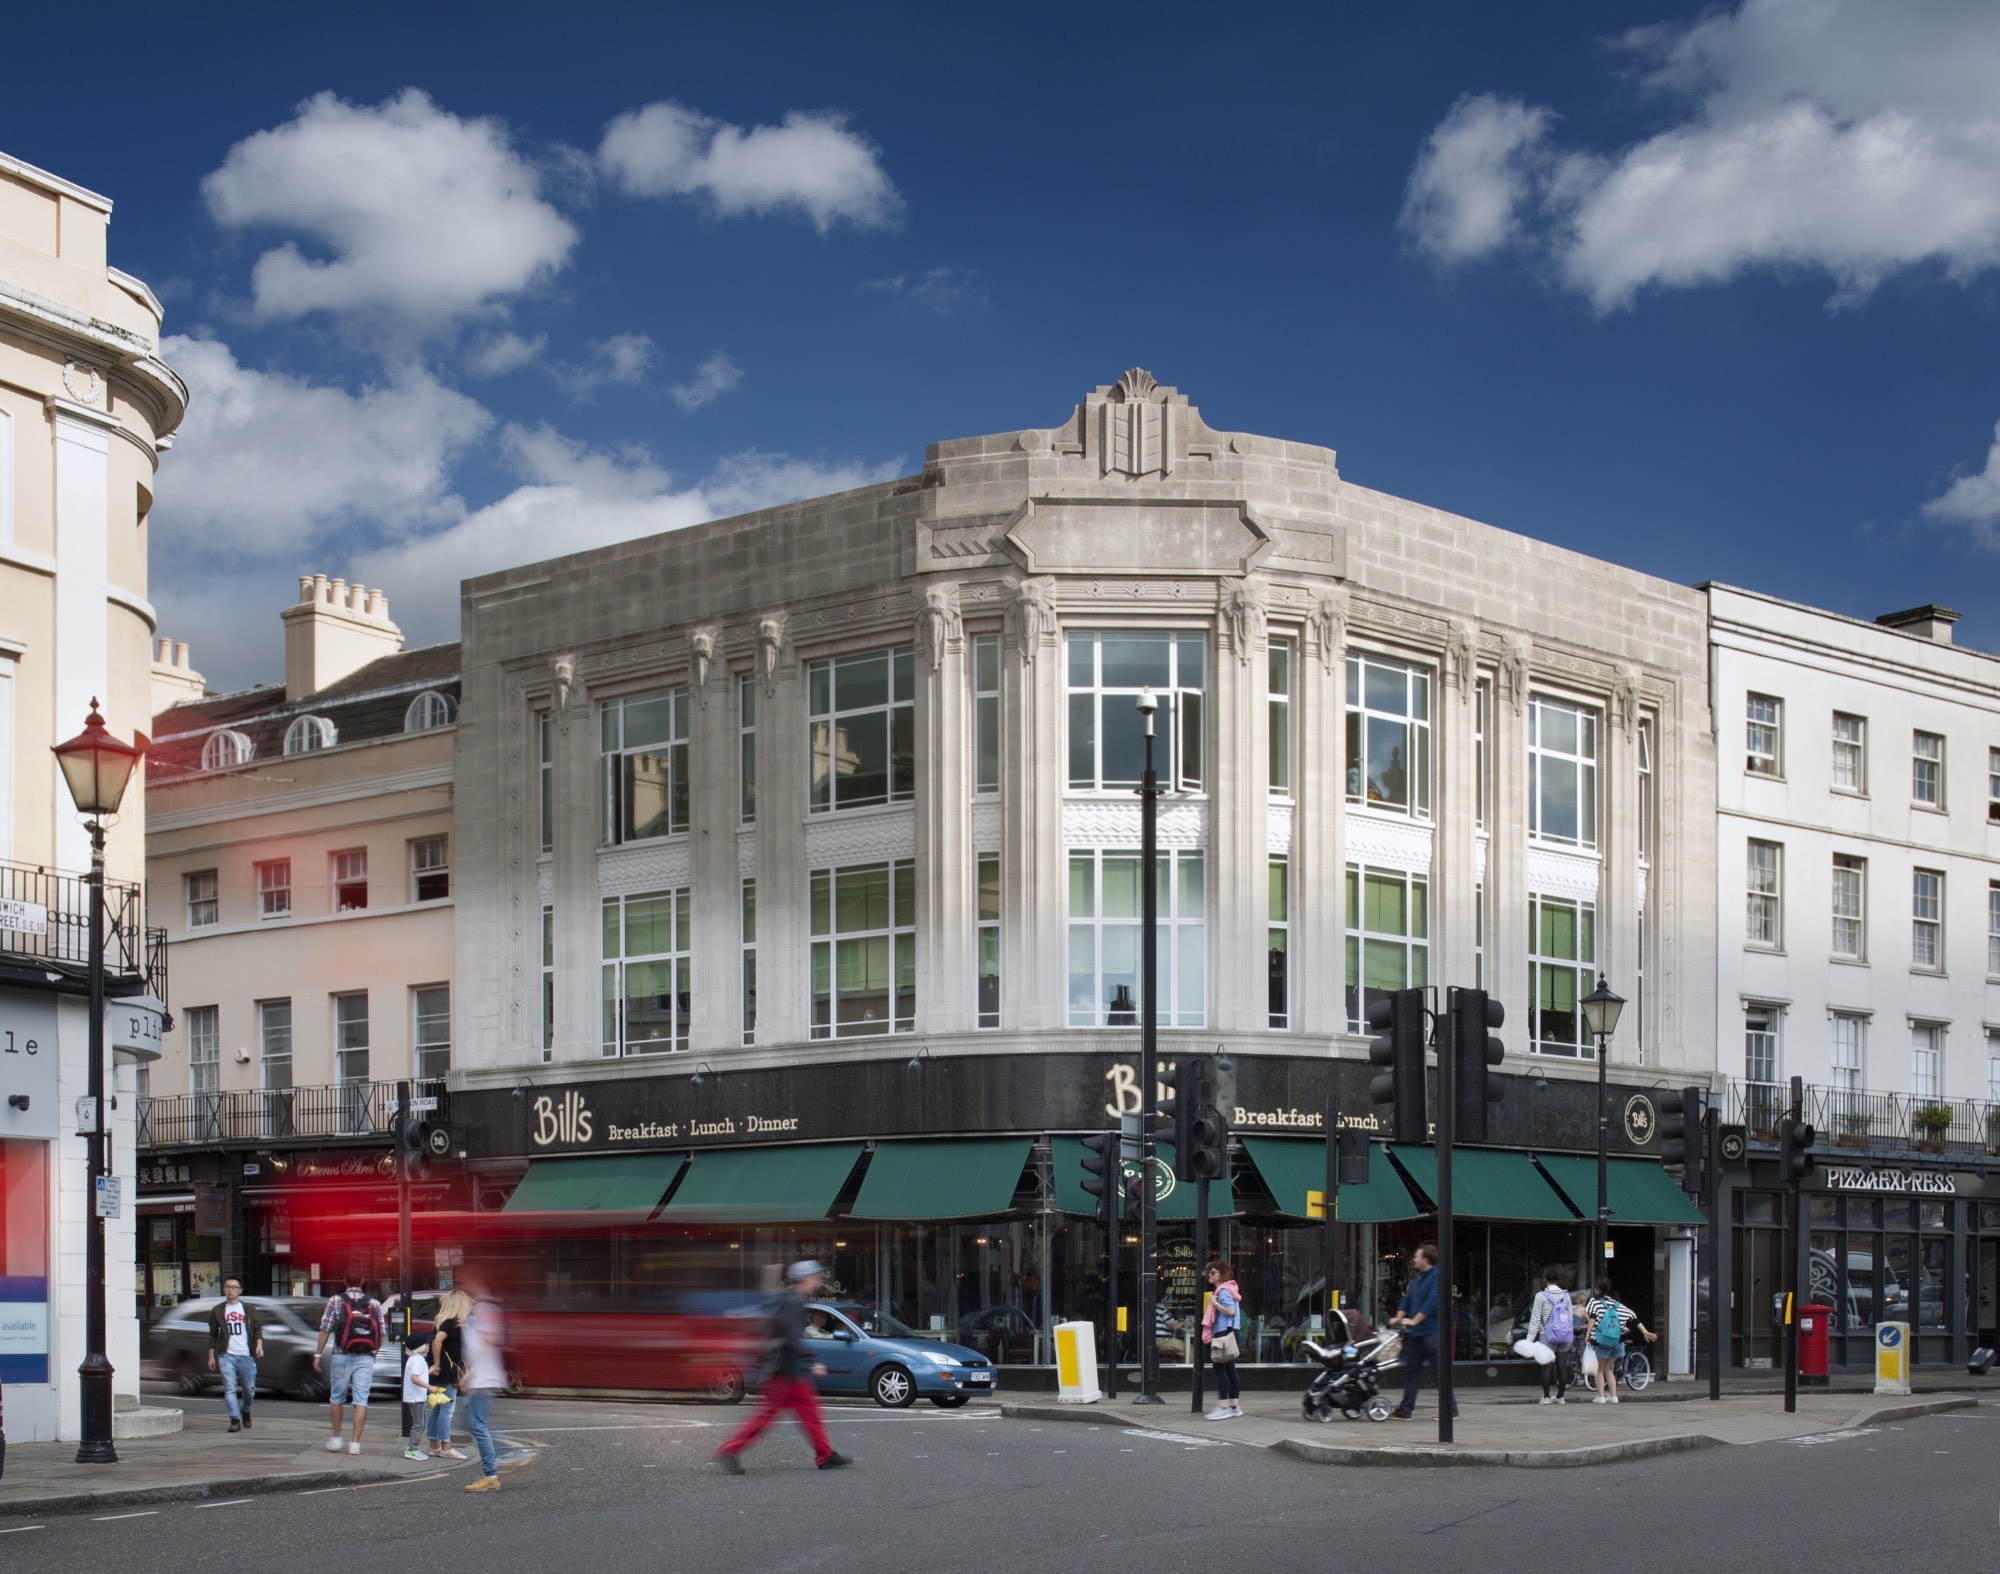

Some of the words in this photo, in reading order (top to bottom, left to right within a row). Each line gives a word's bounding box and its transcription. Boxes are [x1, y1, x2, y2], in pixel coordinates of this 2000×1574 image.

[420, 1098, 437, 1106] ROAD
[534, 1091, 592, 1146] Bill's
[1233, 1107, 1322, 1127] Breakfast
[608, 1123, 678, 1140] Breakfast
[690, 1118, 735, 1136] Lunch
[747, 1115, 798, 1132] Dinner
[1174, 1245, 1193, 1258] Bill's
[1164, 1269, 1196, 1278] BREAKFA
[1175, 1287, 1196, 1295] DINN
[2, 1321, 36, 1331] available
[227, 1323, 242, 1336] 10
